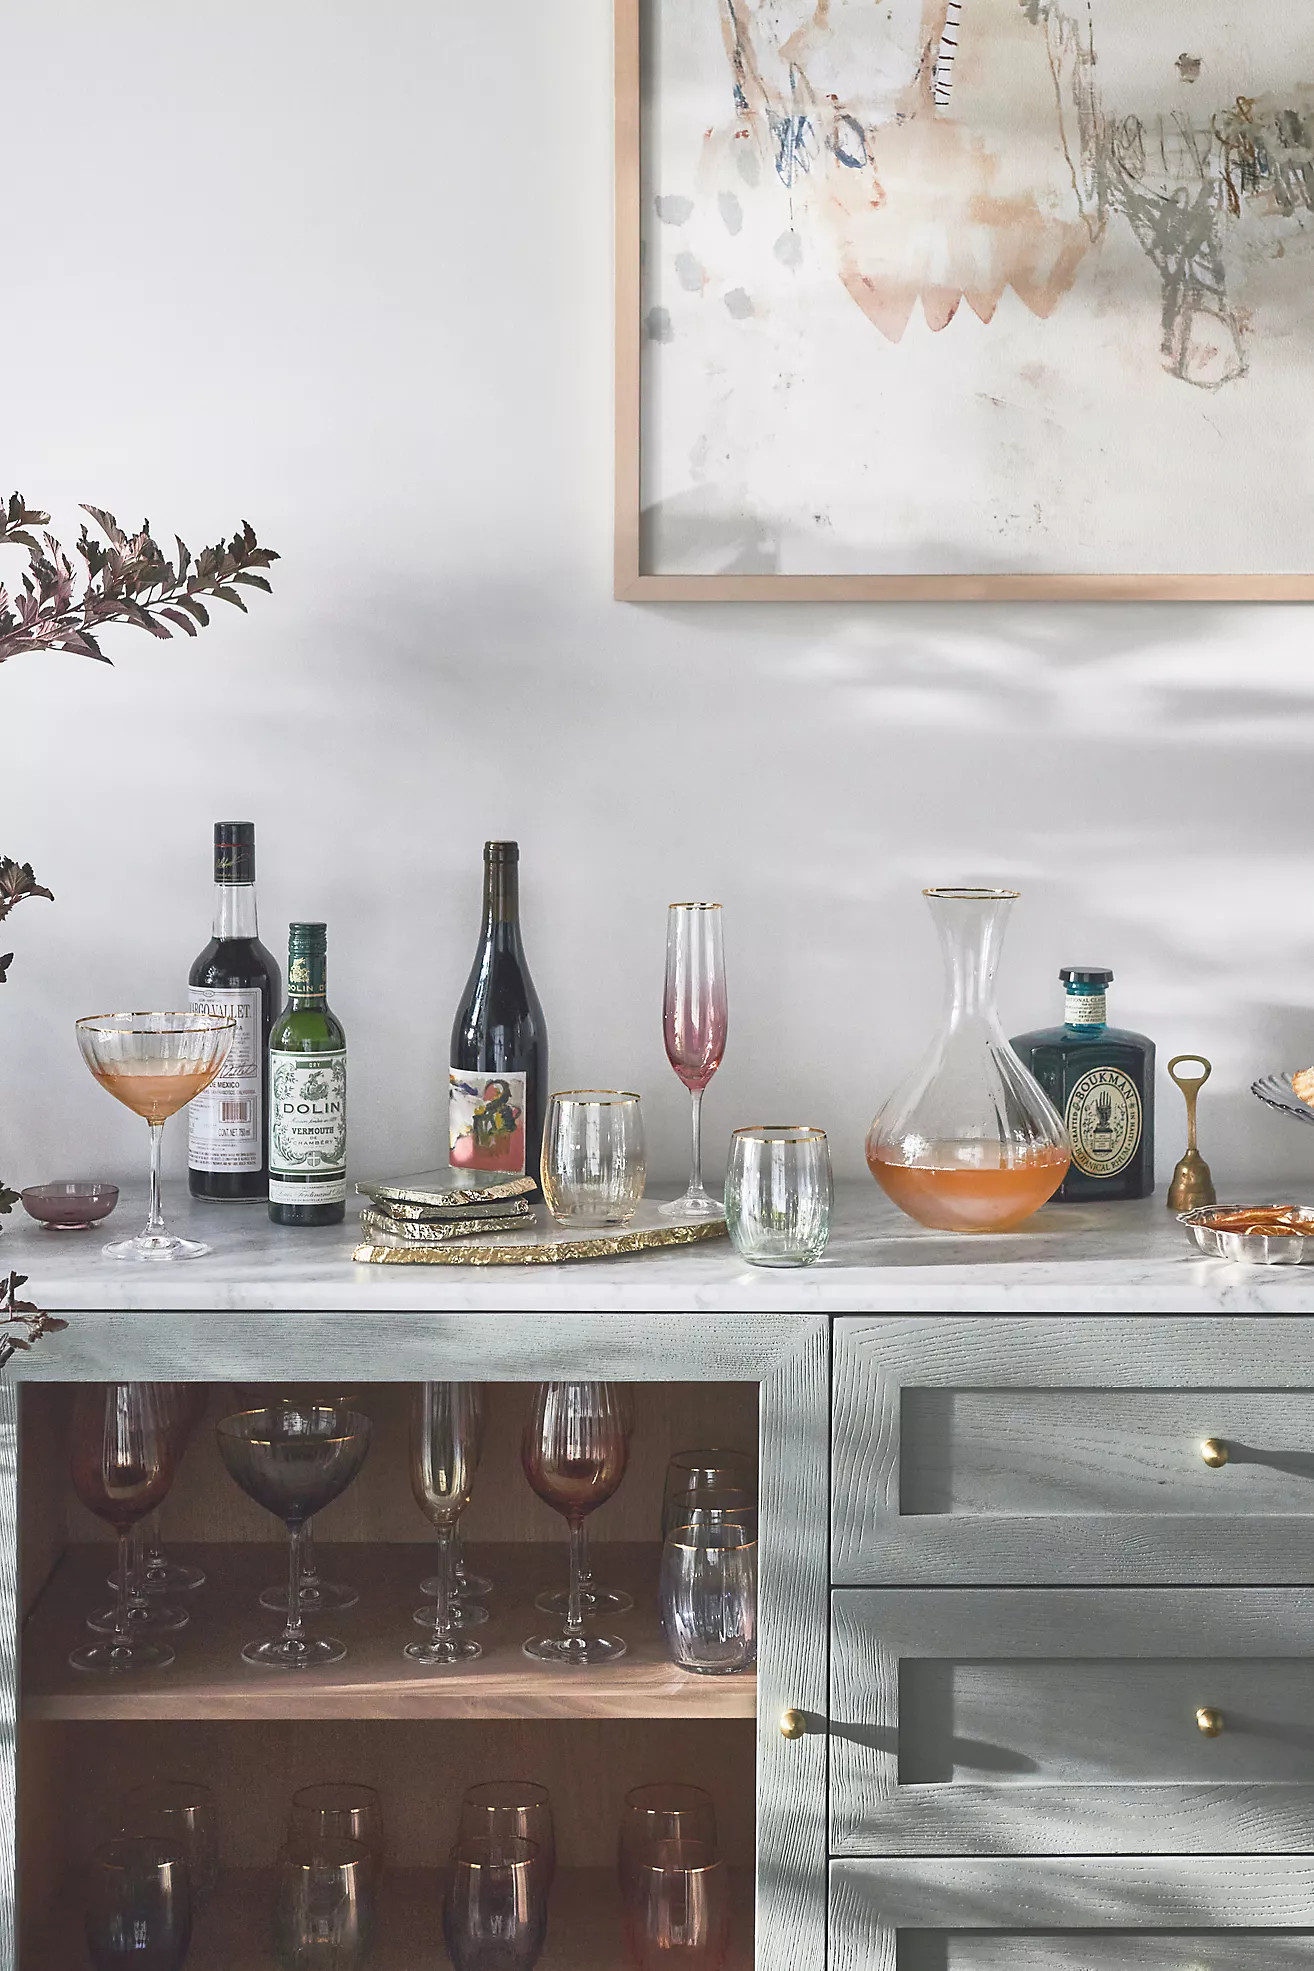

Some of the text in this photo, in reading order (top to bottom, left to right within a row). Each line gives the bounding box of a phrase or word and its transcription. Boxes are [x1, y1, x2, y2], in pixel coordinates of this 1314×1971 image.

[1075, 1072, 1134, 1100] BOUKMAN
[283, 1102, 340, 1114] DOLIN
[1130, 1111, 1135, 1120] IN
[291, 1126, 334, 1135] VERMOUTH
[1075, 1147, 1130, 1171] BOTANICAL RHUM
